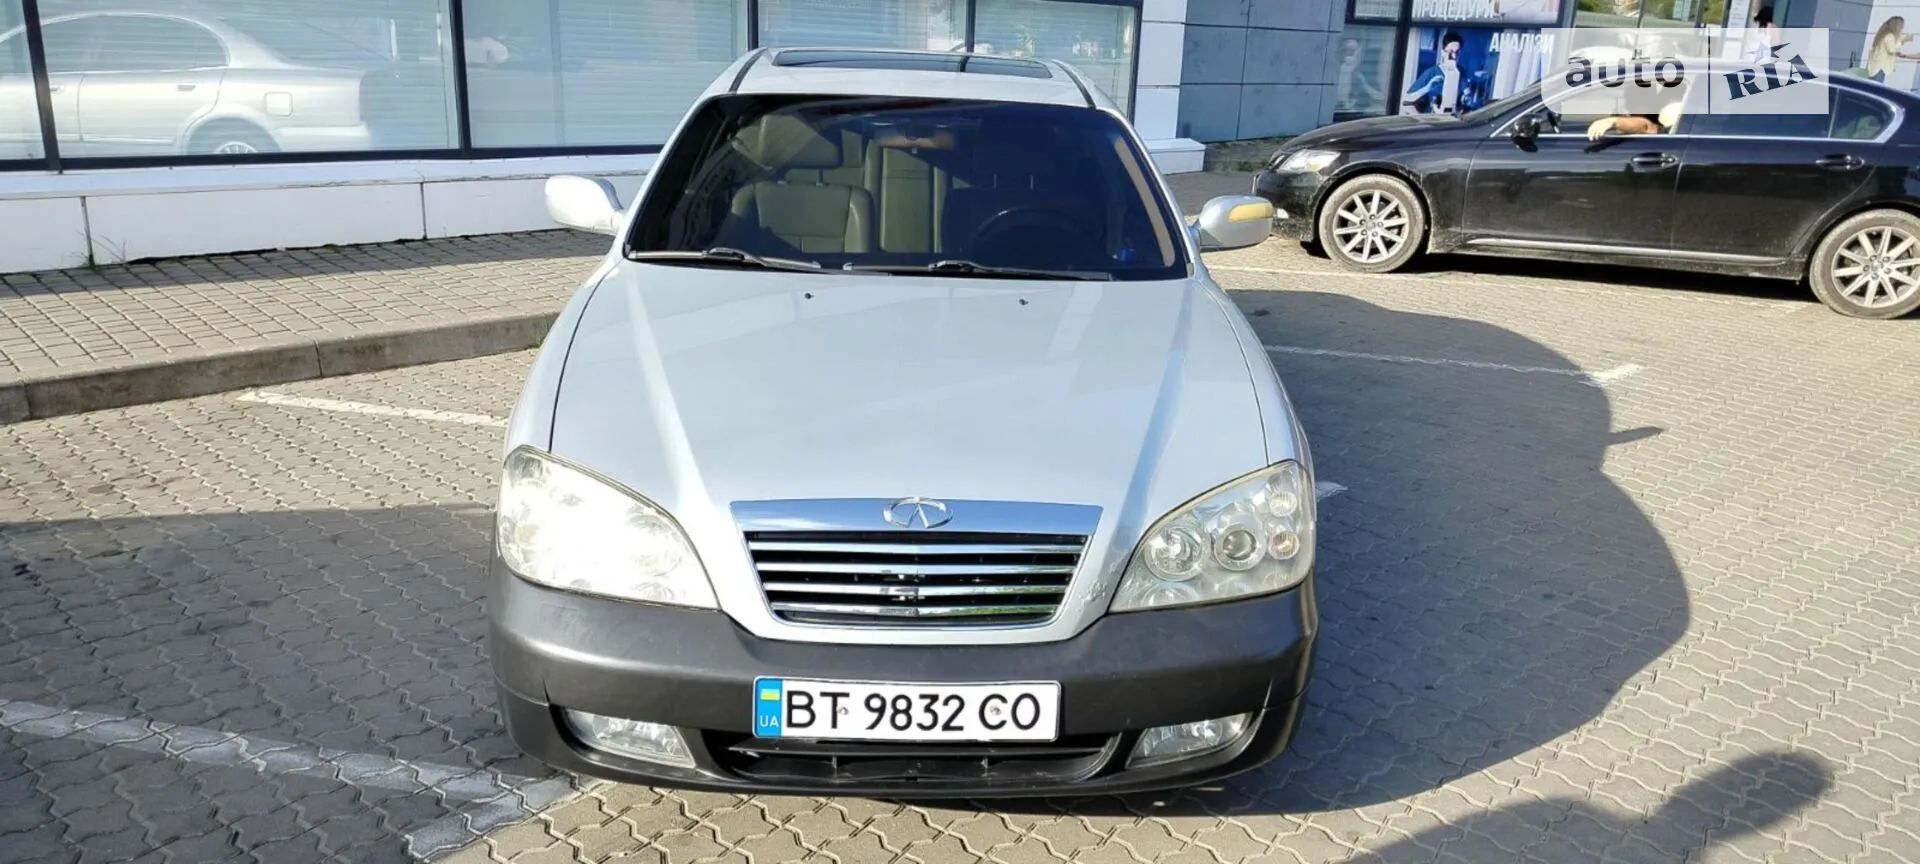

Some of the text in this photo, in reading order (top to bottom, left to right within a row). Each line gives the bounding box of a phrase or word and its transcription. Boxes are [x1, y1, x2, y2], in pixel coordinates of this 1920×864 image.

[1489, 32, 1555, 53] АНАЛІЗИ
[759, 714, 780, 728] UA
[786, 690, 1040, 732] BT 9832 CO
